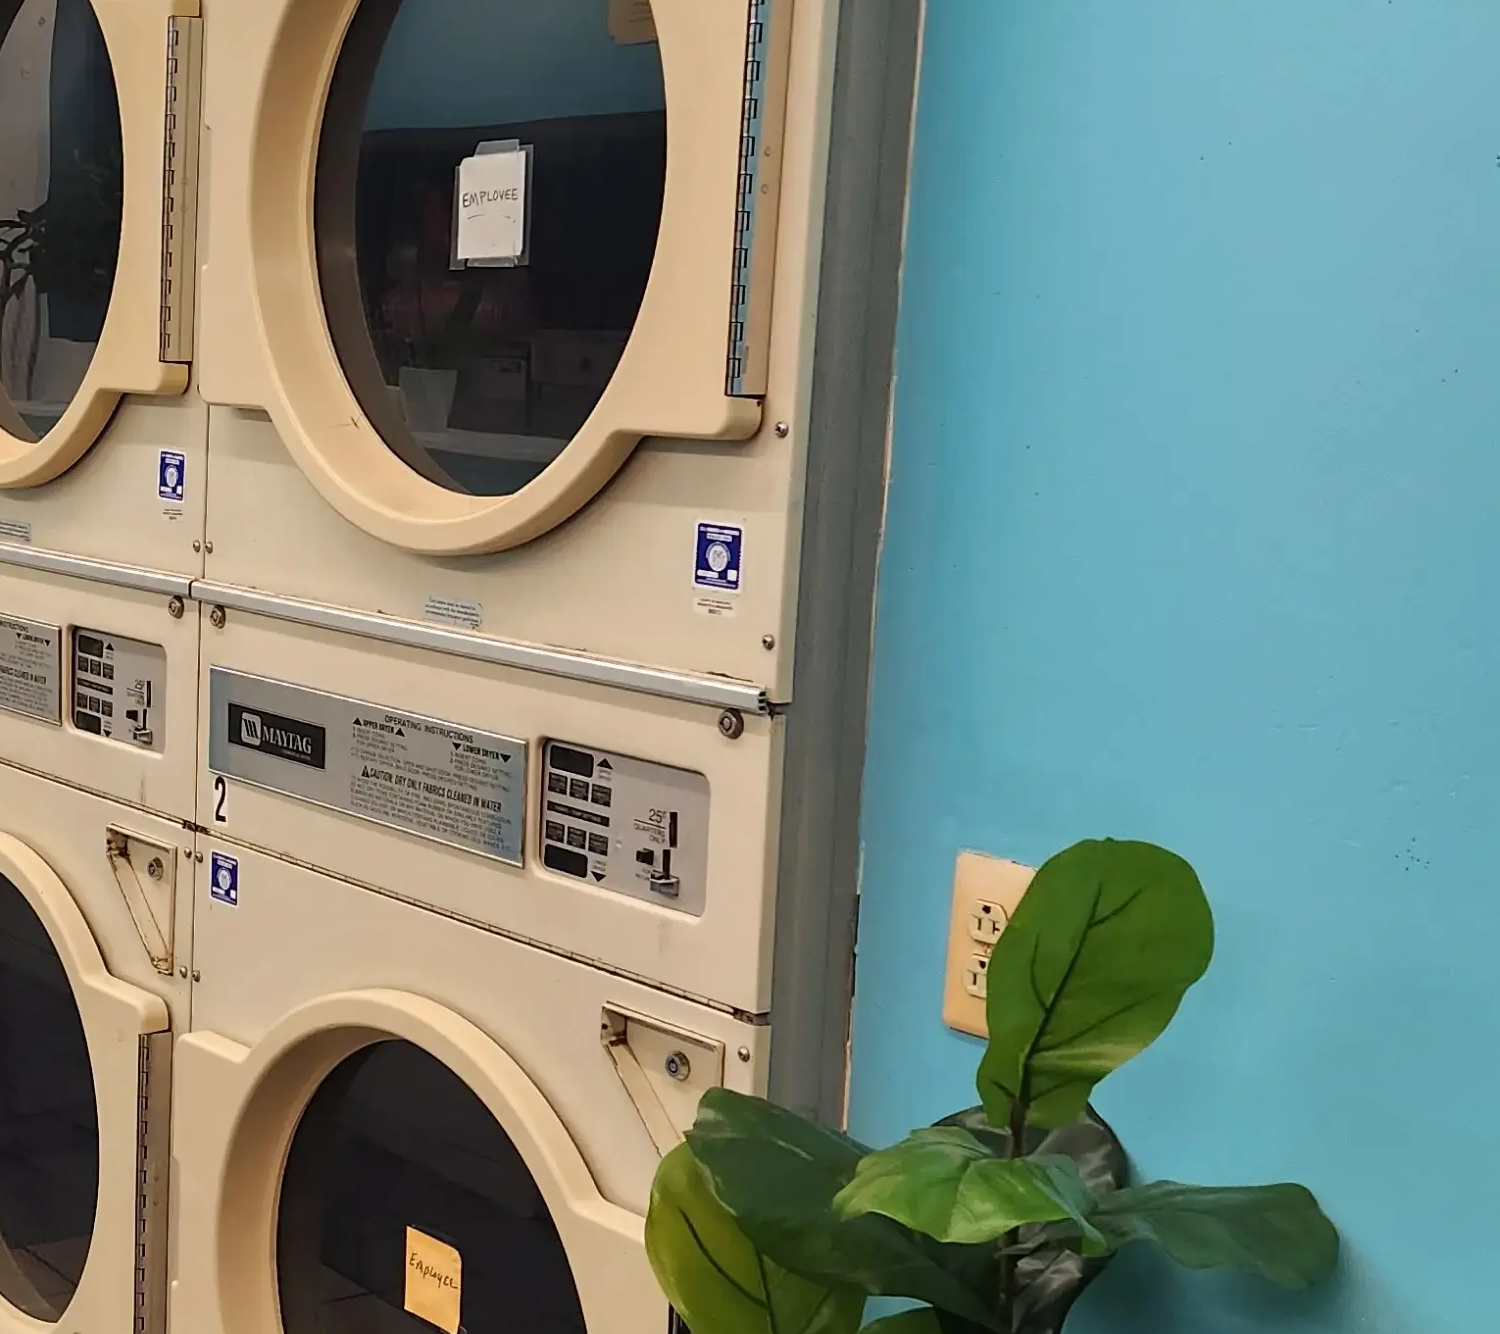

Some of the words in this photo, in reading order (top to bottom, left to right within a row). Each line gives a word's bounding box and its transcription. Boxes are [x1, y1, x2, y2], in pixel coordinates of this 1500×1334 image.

[462, 188, 519, 208] EMPLOYEE
[262, 725, 312, 753] MAYTAG
[384, 715, 421, 731] OPERATING
[424, 725, 474, 743] INSTRUCTIONS
[214, 775, 226, 823] 2
[481, 798, 502, 813] WATER
